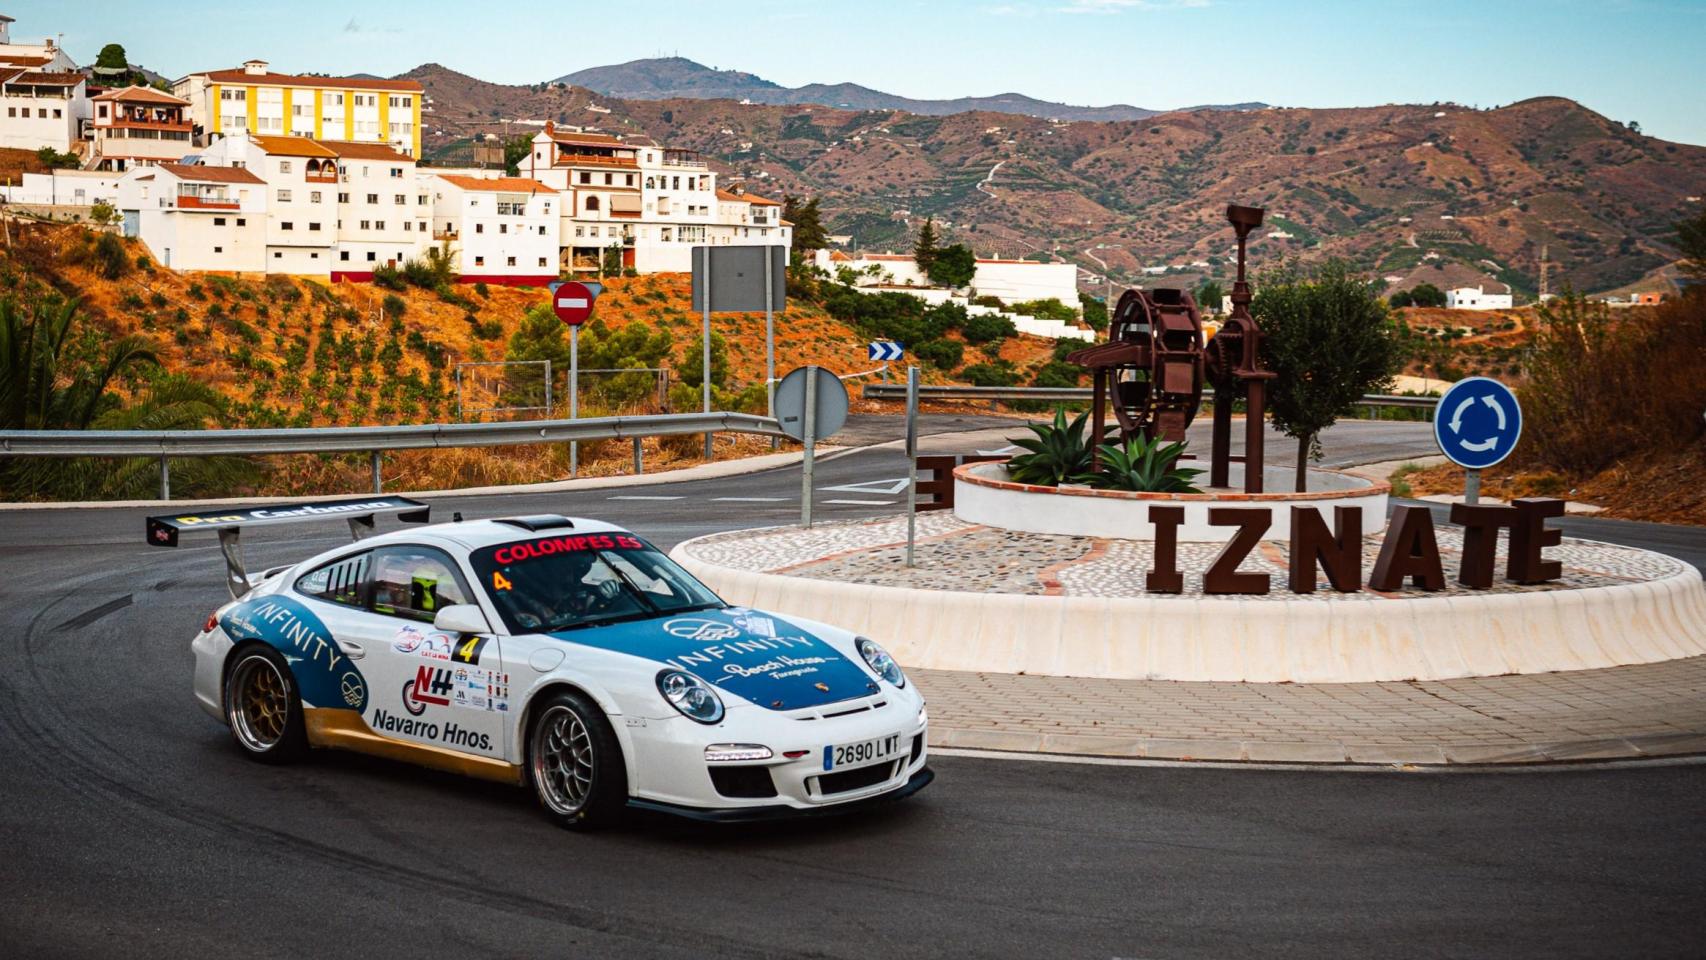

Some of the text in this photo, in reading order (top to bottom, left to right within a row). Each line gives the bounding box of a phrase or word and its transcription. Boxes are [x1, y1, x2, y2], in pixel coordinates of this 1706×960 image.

[1146, 499, 1566, 594] IZNATE
[492, 571, 512, 591] 4
[253, 602, 341, 671] INFINITY
[460, 637, 480, 663] 4
[666, 635, 814, 670] INFINITY
[723, 655, 826, 677] Beach House
[373, 708, 493, 751] Navarro Hnos.
[836, 735, 898, 765] 2690 LVT
